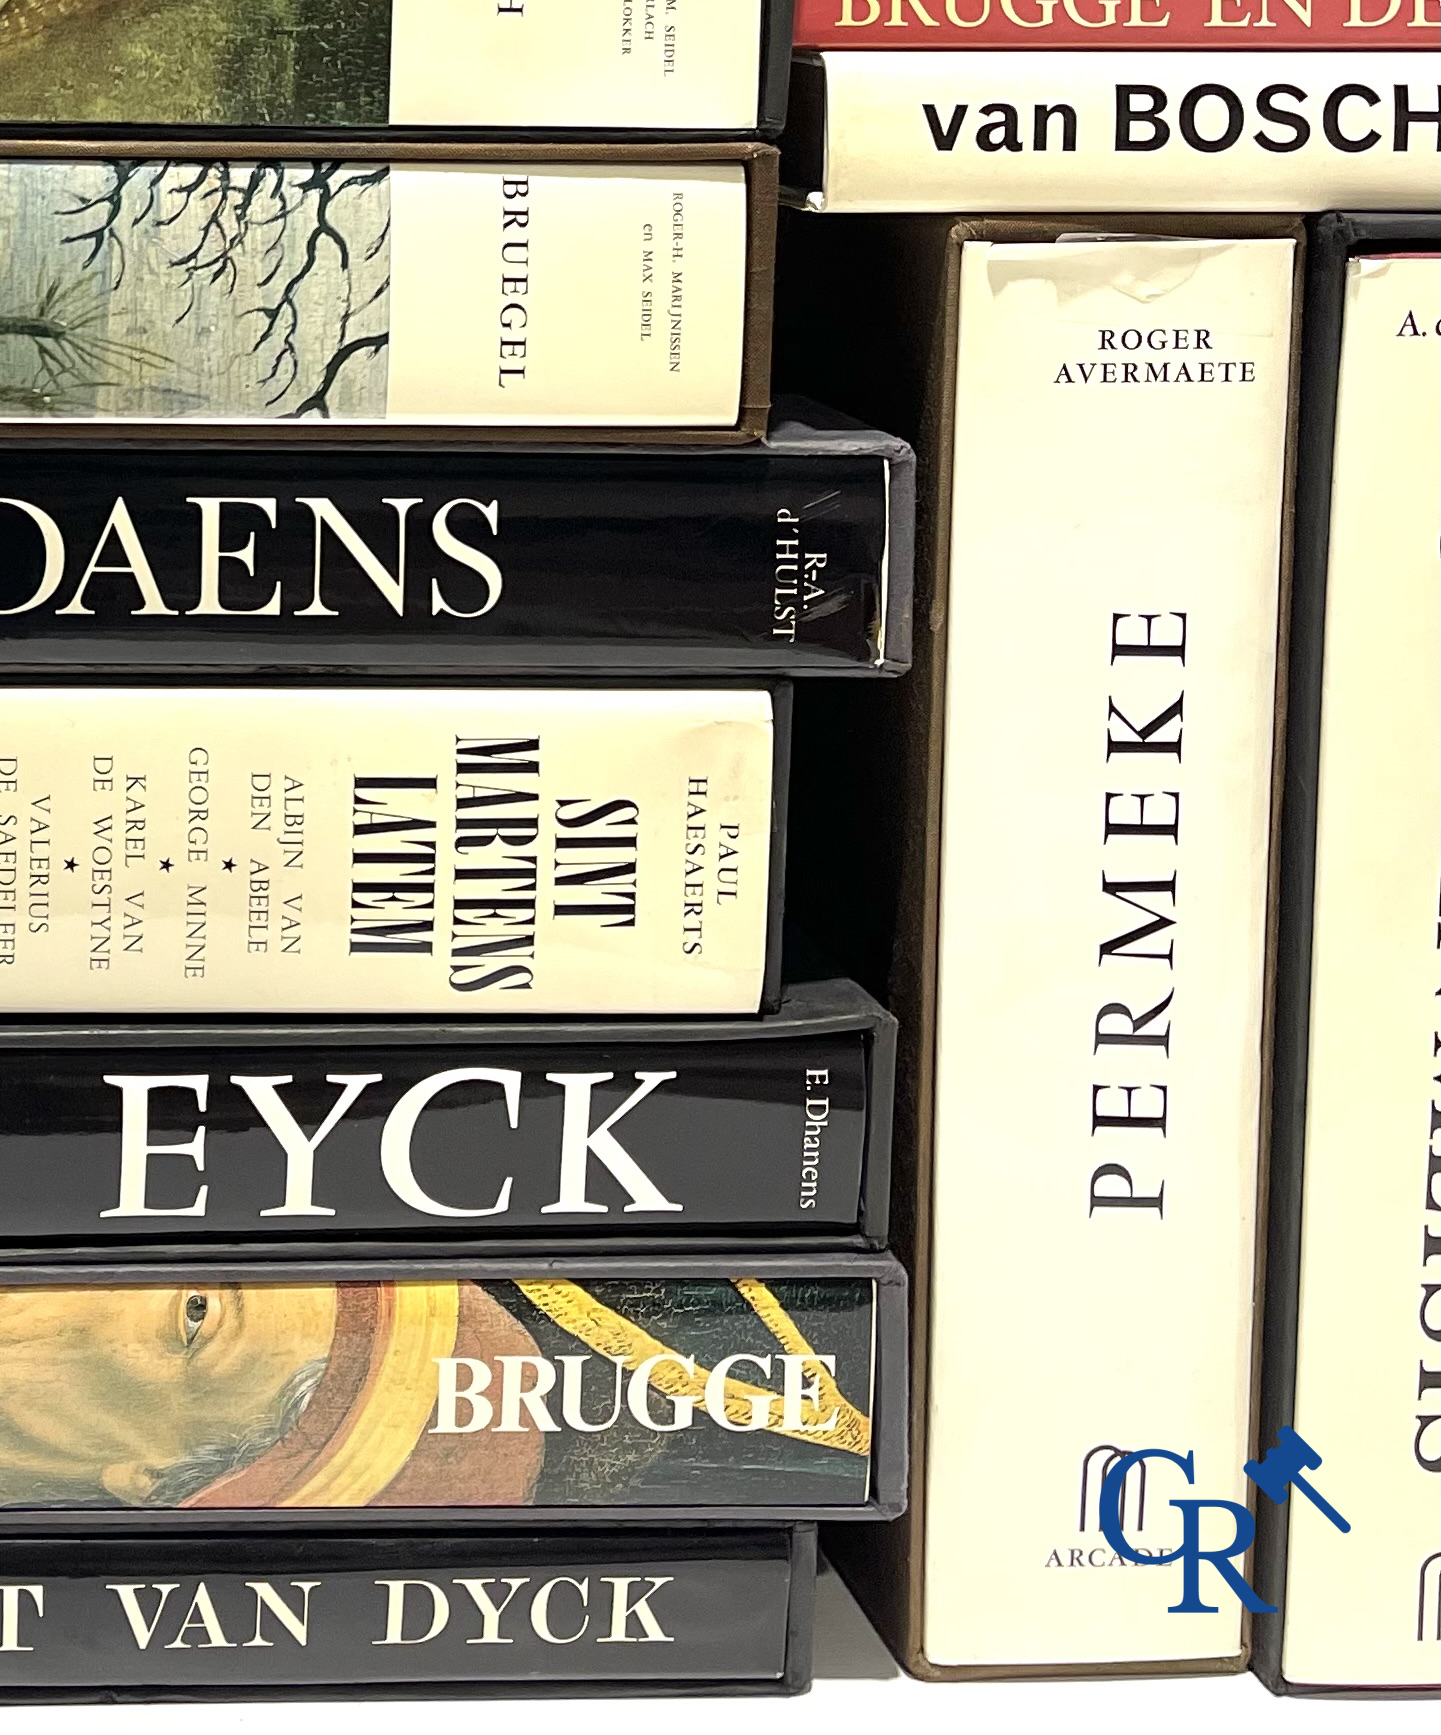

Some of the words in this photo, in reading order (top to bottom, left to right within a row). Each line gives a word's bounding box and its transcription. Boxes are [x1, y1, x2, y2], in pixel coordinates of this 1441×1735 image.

[663, 24, 677, 78] SEIDEL
[921, 102, 1079, 153] van
[1114, 82, 1441, 153] BOSCH
[641, 249, 654, 284] MAX
[642, 222, 654, 243] en
[497, 174, 530, 389] BRUEGEL
[640, 289, 654, 342] SEIDEL
[667, 270, 684, 374] MARIJNISSEN
[1053, 360, 1257, 385] AVERMAETE
[1097, 327, 1213, 351] ROGER
[92, 755, 114, 793] DE
[124, 773, 147, 869] KAREL
[187, 746, 210, 864] GEORGE
[250, 771, 272, 832] DEN
[276, 773, 305, 871] ALBIJN
[28, 793, 51, 934] VALERIUS
[89, 814, 113, 971] WOESTYNE
[247, 857, 271, 955] ABEELE
[349, 773, 438, 957] LATEM
[448, 734, 541, 993] MARTENS
[553, 798, 640, 929] SINT
[681, 774, 709, 956] HAESAERTS
[716, 822, 741, 906] PAUL
[122, 889, 145, 954] VAN
[184, 882, 208, 979] MINNE
[280, 892, 303, 955] VAN
[1088, 611, 1188, 1221] PERMEKE
[805, 1068, 830, 1092] E.
[99, 1066, 686, 1220] EYCK
[799, 1096, 830, 1209] Dhanens
[426, 1352, 839, 1435] BRUGGE
[105, 1579, 323, 1653] VAN
[370, 1574, 676, 1647] DYCK
